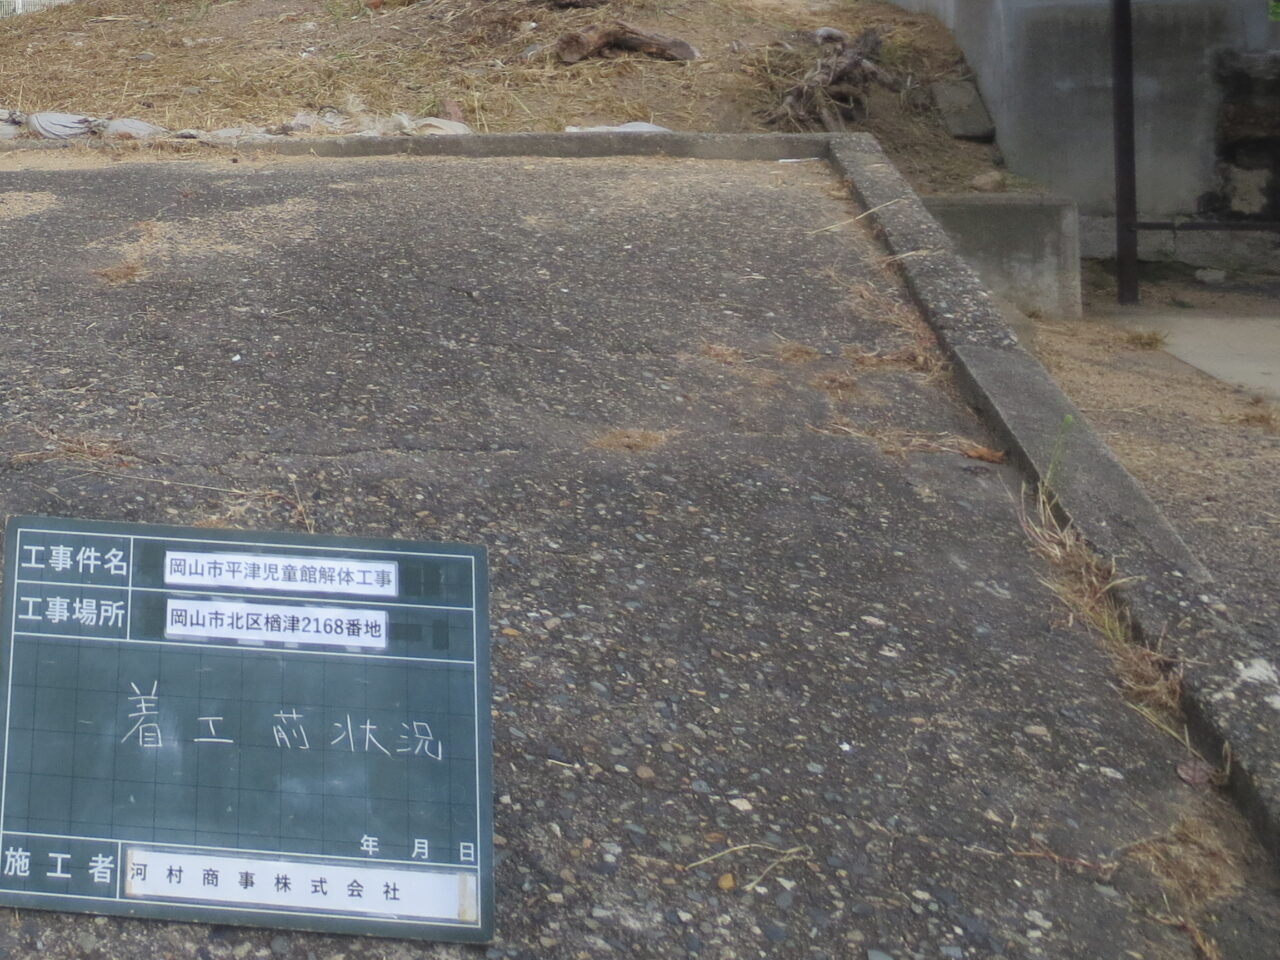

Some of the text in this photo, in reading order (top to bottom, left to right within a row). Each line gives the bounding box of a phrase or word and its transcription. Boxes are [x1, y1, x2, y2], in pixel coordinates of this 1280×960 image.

[21, 545, 128, 576] 工事件名
[170, 558, 393, 588] 岡山市平津児童館解体工事
[18, 596, 126, 628] 工事場所
[170, 608, 383, 639] 岡山市北区楢津2168番地
[121, 680, 443, 761] 着工前状況
[4, 847, 115, 884] 施工者
[130, 862, 401, 902] 河村商事株式会社
